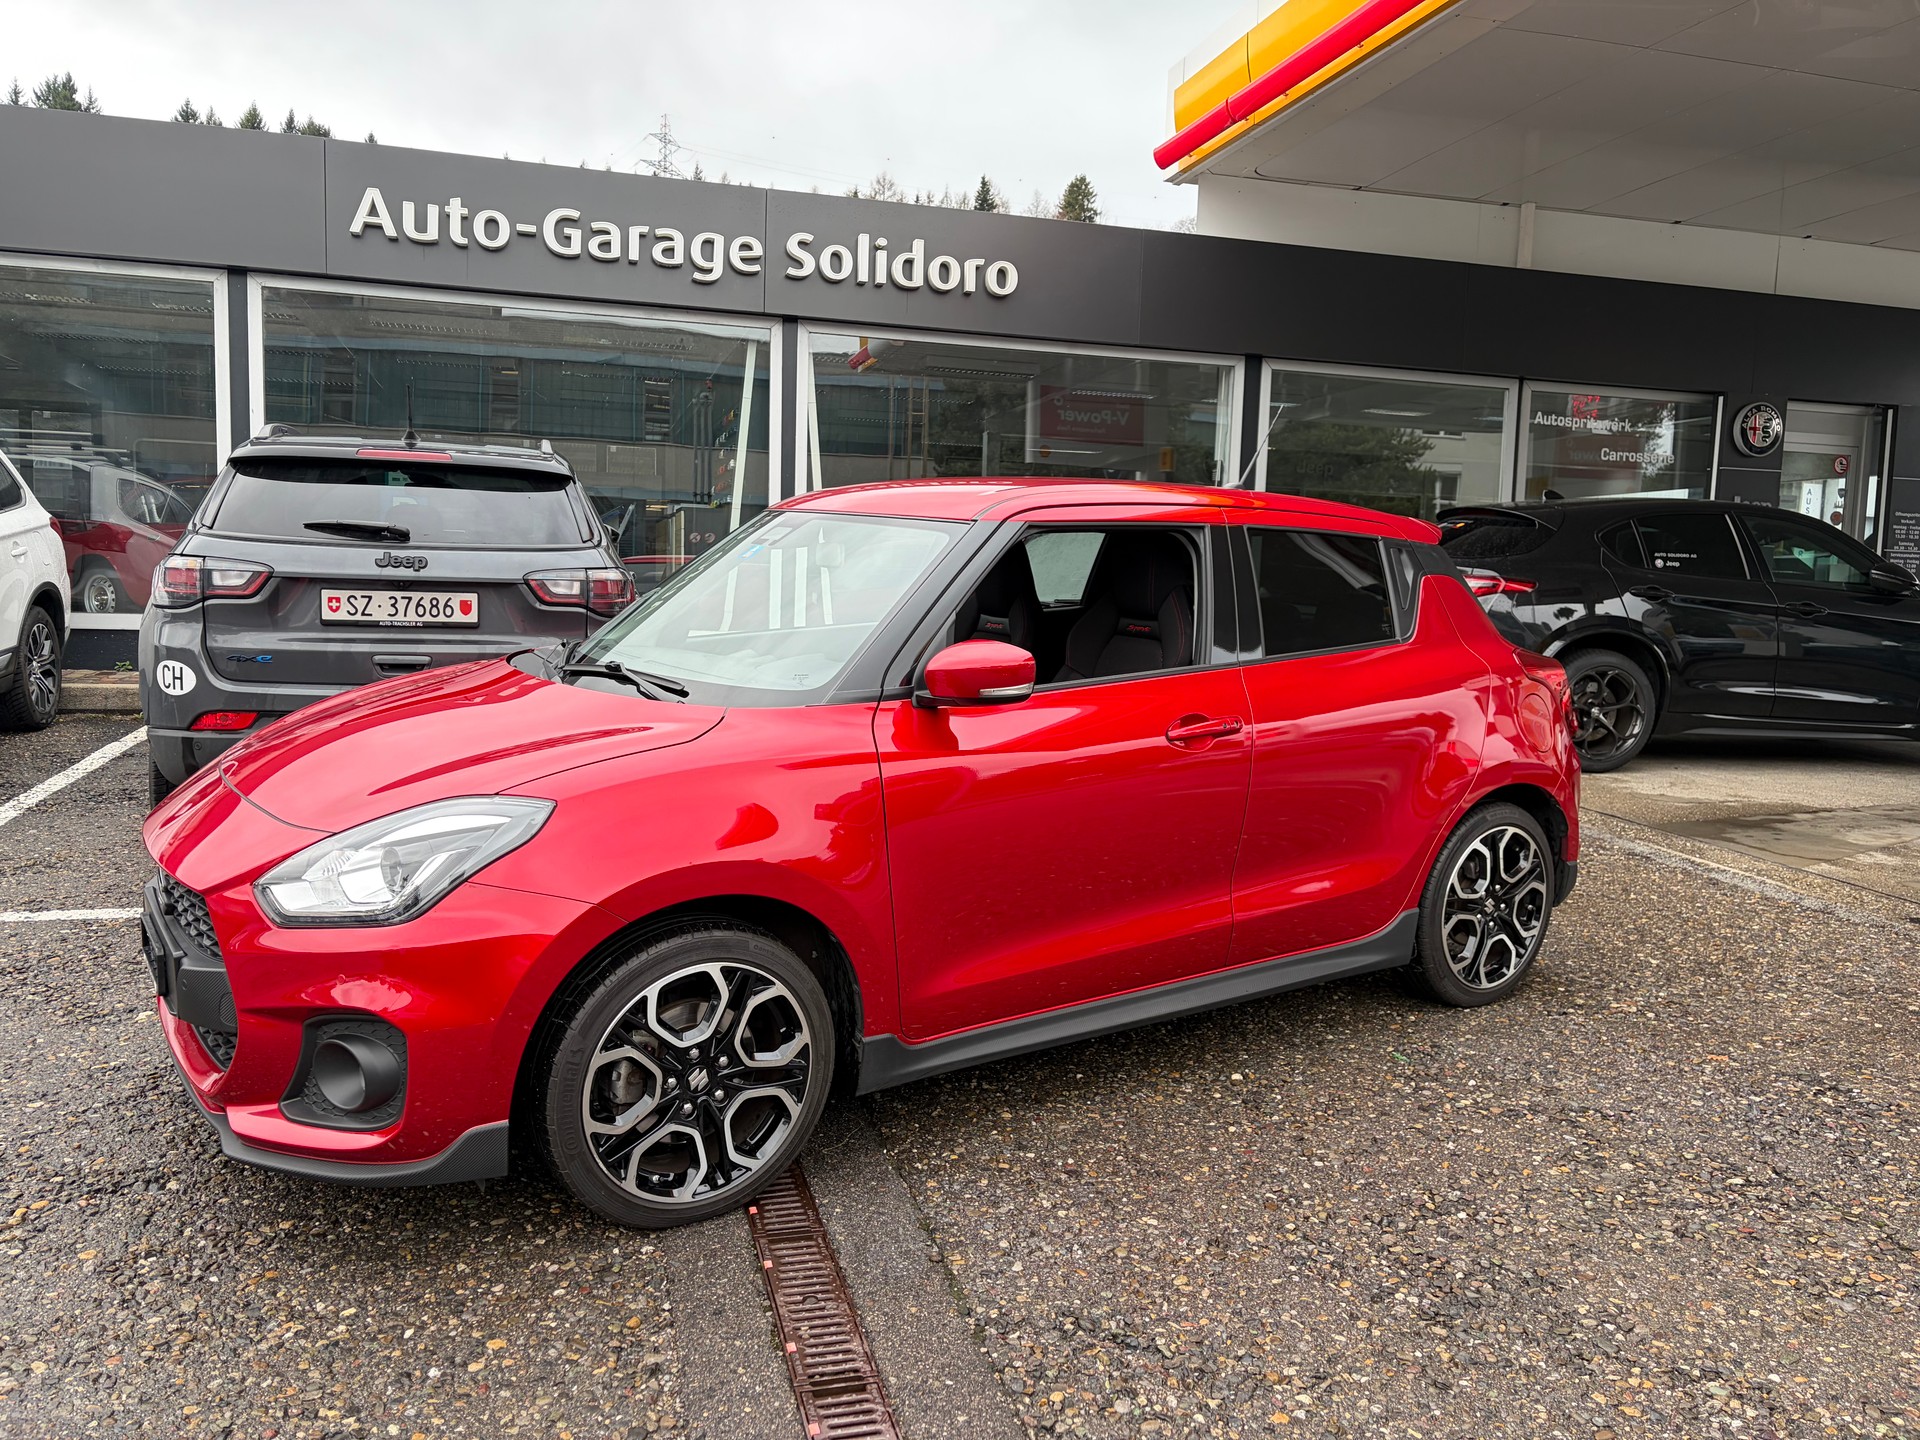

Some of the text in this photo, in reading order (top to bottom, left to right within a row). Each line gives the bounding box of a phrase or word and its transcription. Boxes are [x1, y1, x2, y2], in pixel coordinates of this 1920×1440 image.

[349, 186, 1019, 298] Auto-Garage Solidoro
[1741, 405, 1781, 432] ALFA ROMEO
[375, 552, 429, 572] Jeep
[1665, 560, 1681, 568] Jeep
[346, 594, 373, 617] SZ
[387, 596, 455, 618] 37686
[162, 664, 184, 691] CH
